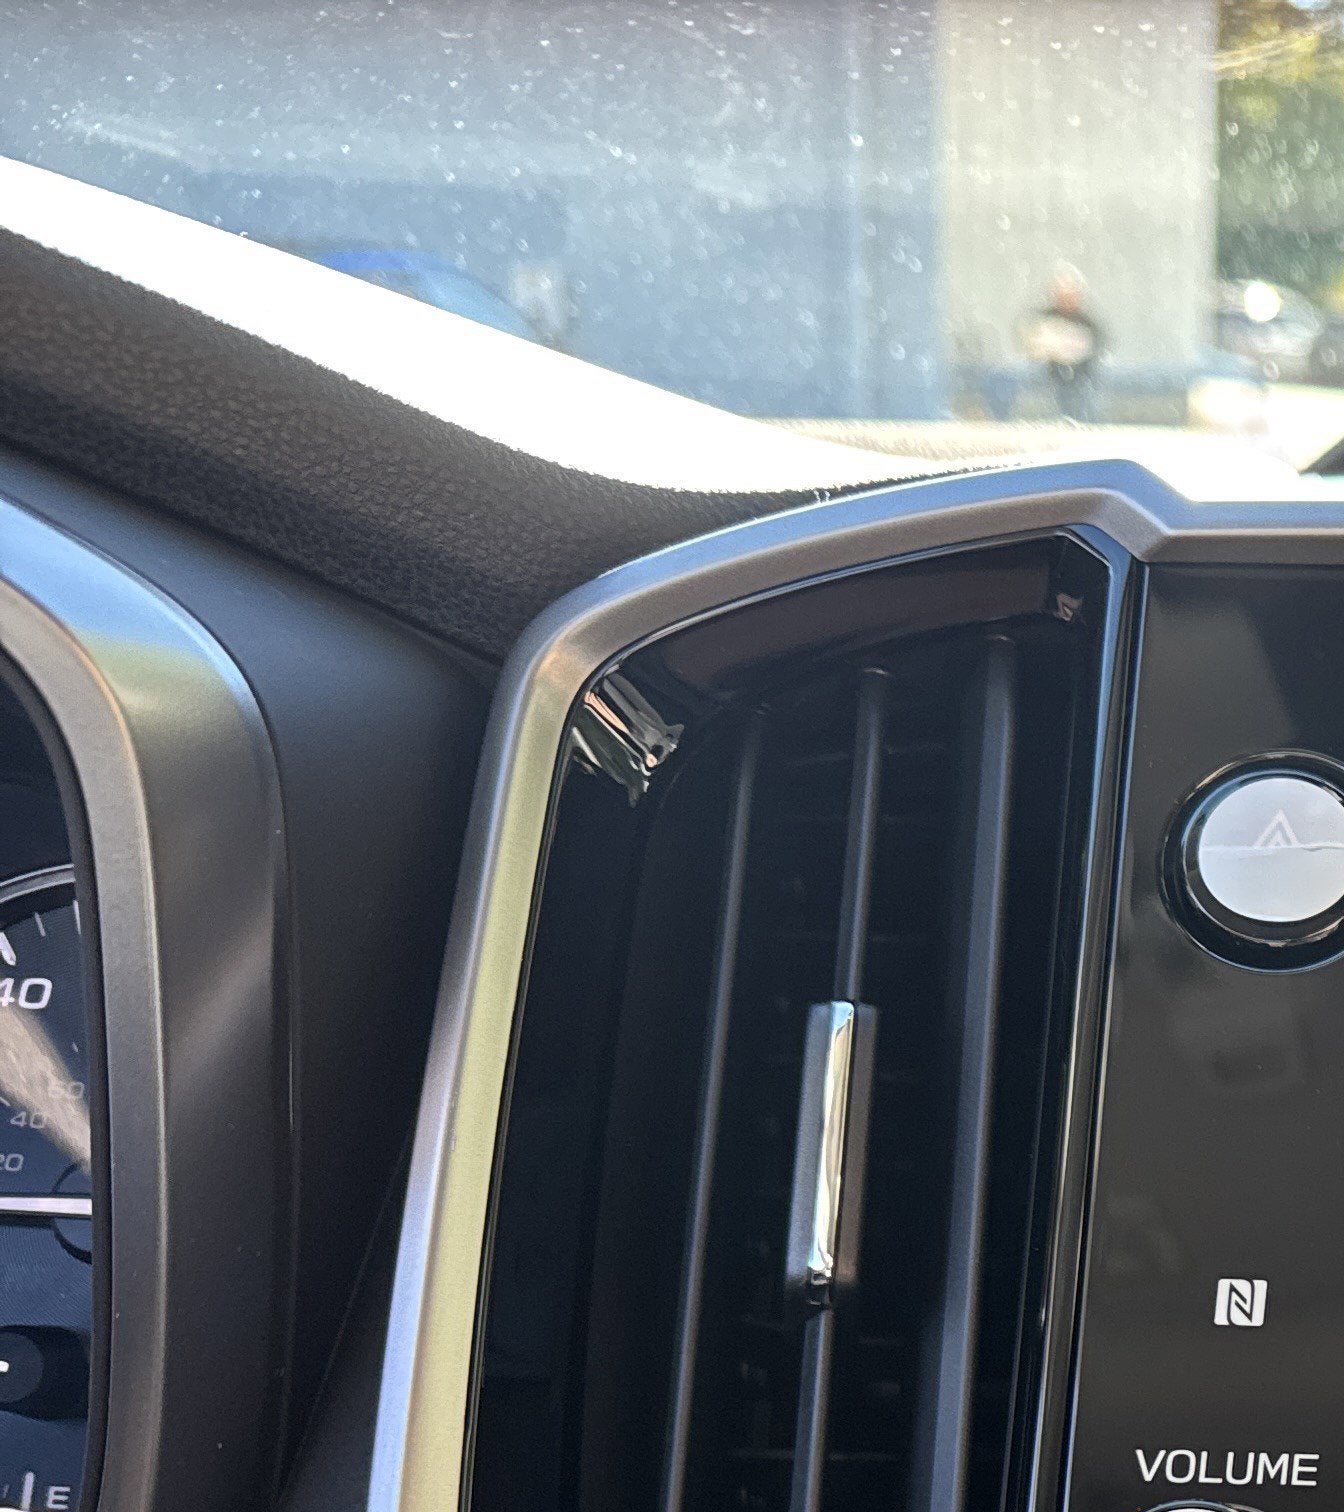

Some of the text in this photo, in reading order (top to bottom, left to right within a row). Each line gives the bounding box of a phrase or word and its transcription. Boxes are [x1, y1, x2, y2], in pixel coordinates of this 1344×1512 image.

[10, 1111, 46, 1129] 40
[0, 1153, 24, 1172] 0
[1135, 1448, 1320, 1486] VOLUME
[46, 1486, 71, 1510] E
